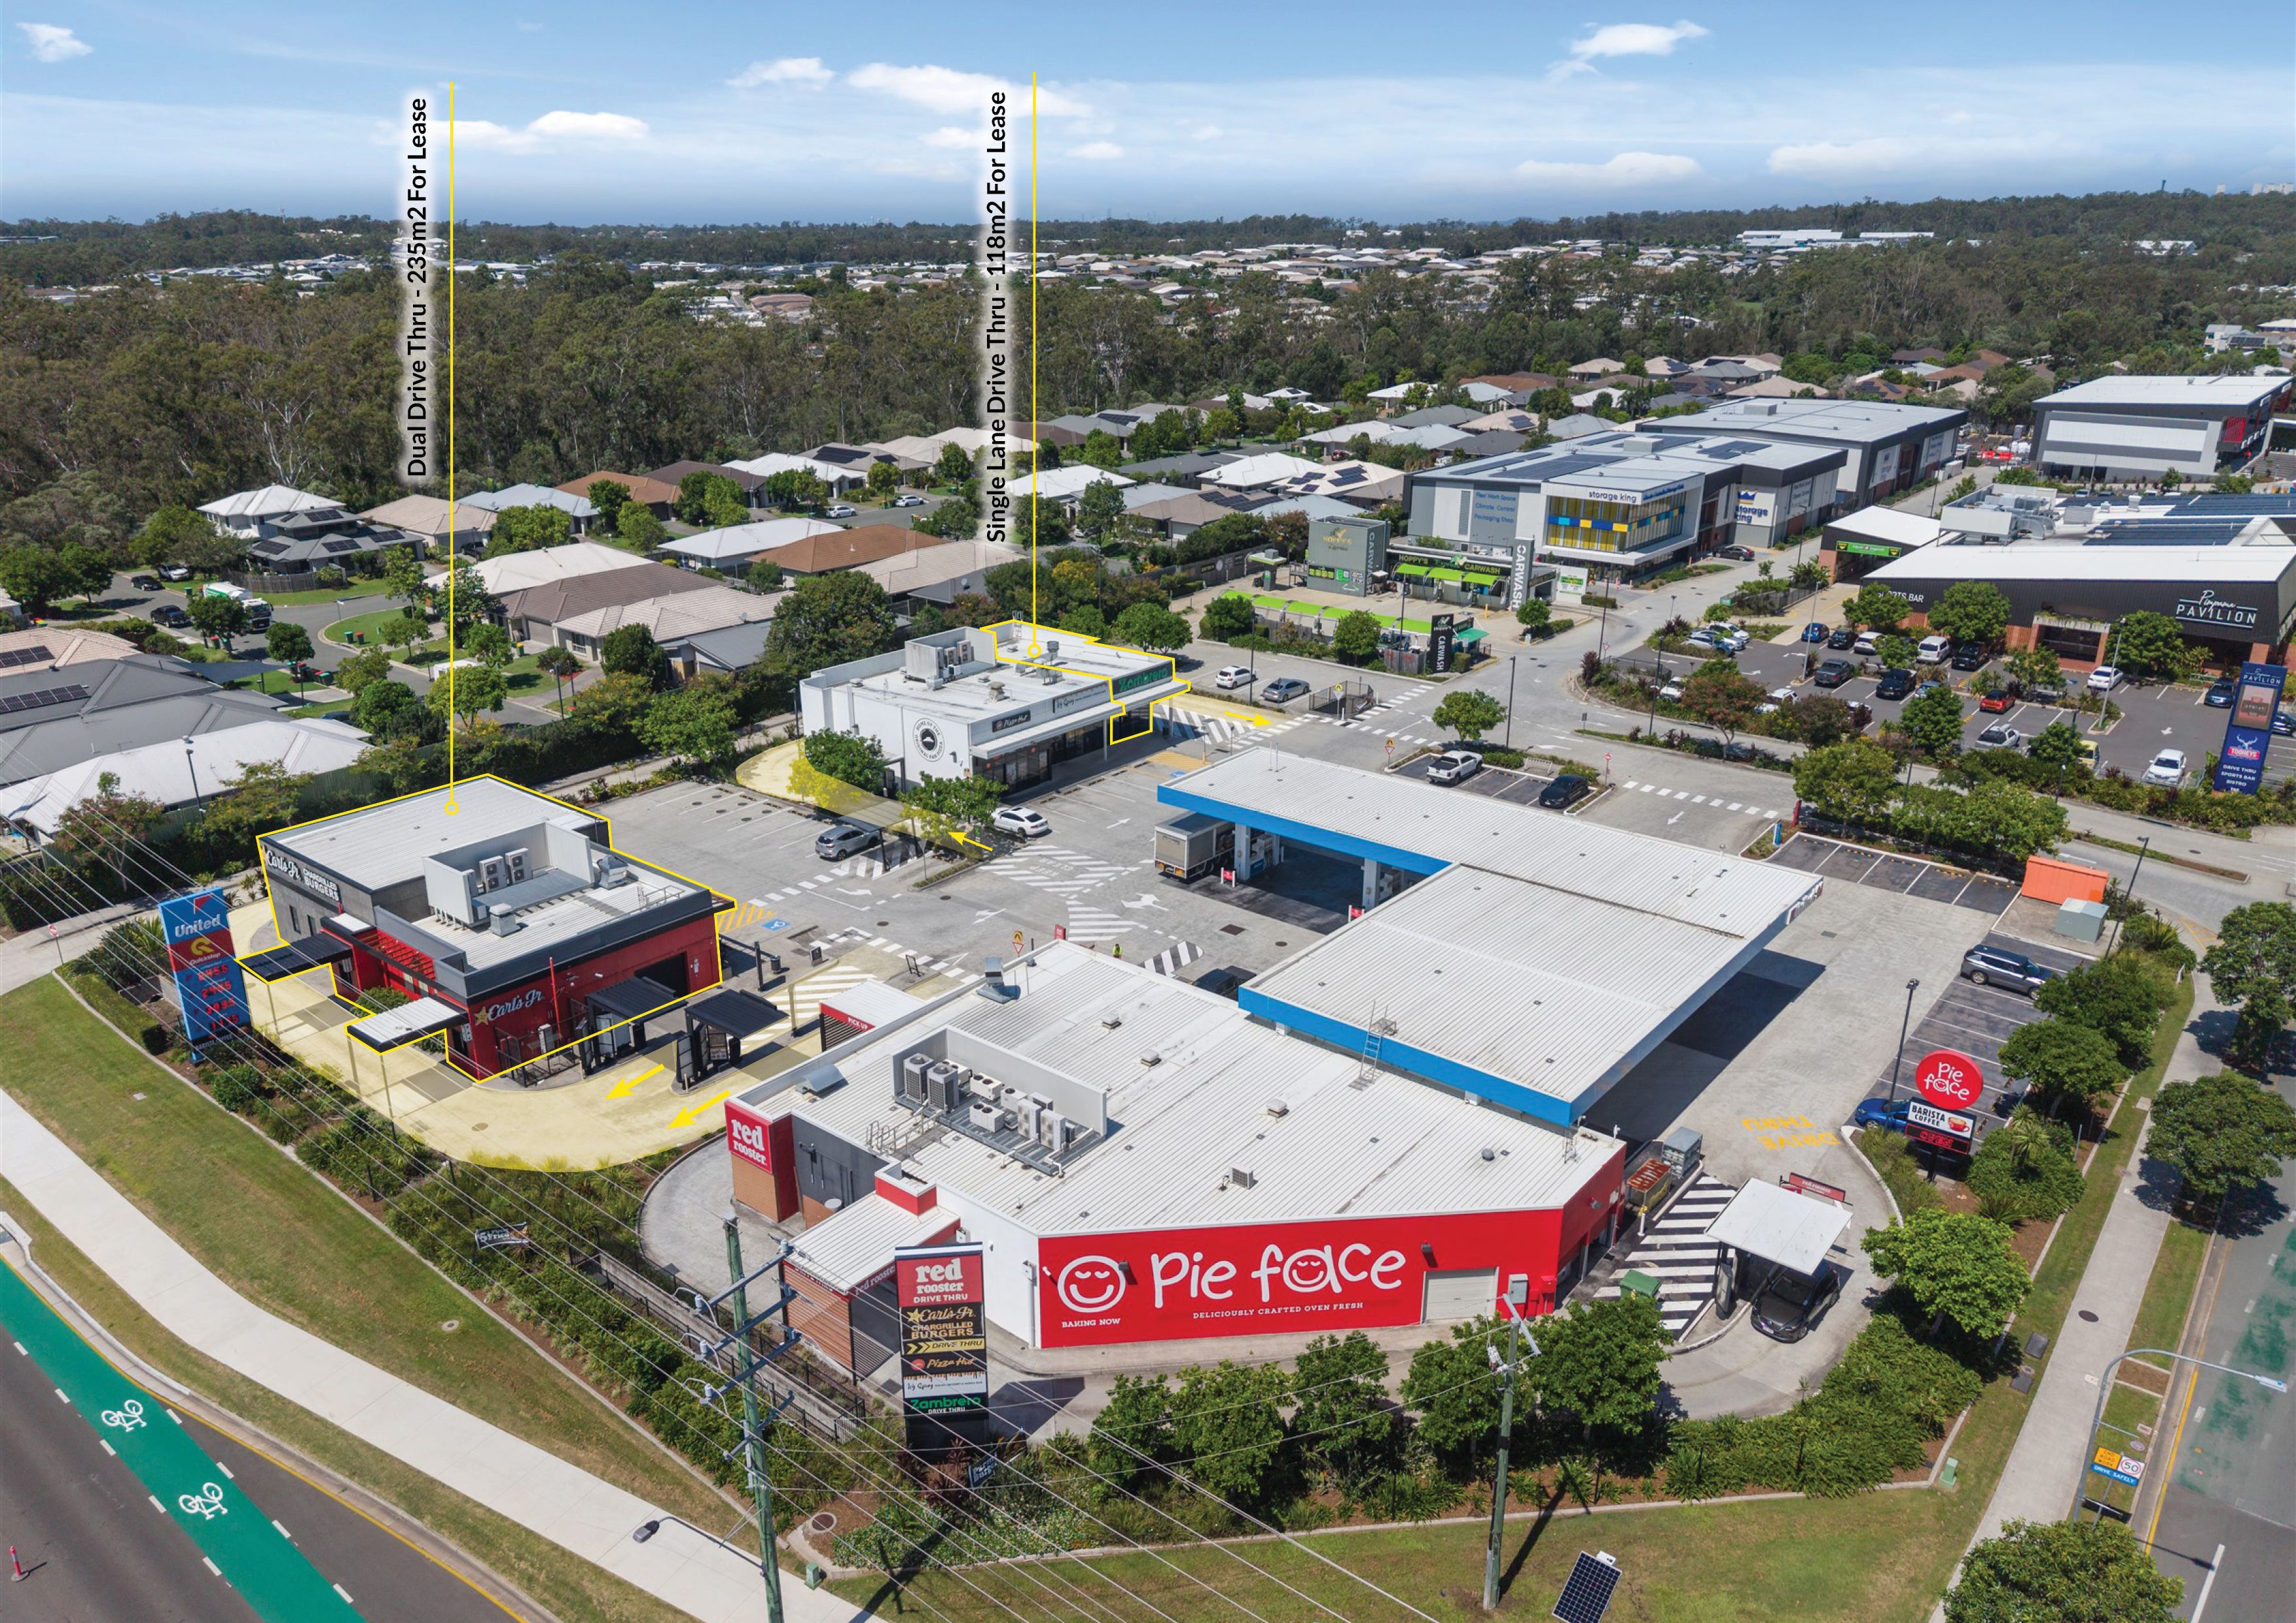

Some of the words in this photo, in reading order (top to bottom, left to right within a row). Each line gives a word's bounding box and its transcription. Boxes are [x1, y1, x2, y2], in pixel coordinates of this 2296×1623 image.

[1588, 491, 1618, 501] storage
[1620, 493, 1637, 503] king
[1399, 554, 1428, 564] HOPPY'S
[1464, 563, 1501, 575] CARWASH
[1513, 544, 1526, 608] CARWASH
[1909, 593, 1924, 603] BAR
[2176, 604, 2256, 624] PAVILION
[1437, 635, 1446, 671] CARWASH
[1119, 668, 1168, 692] Zambrero
[2243, 675, 2281, 684] PAVILION
[2231, 748, 2257, 757] TOOHEYS
[266, 849, 288, 872] Carl's
[304, 876, 339, 901] BURGERS
[175, 914, 221, 937] United
[190, 952, 221, 965] Quickstop
[488, 995, 524, 1021] Carl's
[848, 1016, 860, 1026] PICK
[1924, 1073, 1969, 1101] face
[1912, 1105, 1945, 1122] BARISTA
[1914, 1114, 1940, 1127] COFFEE
[1742, 1115, 1817, 1131] THRU
[731, 1119, 765, 1151] red
[1756, 1132, 1841, 1150] DRIVE
[1920, 1130, 1954, 1148] OPEN
[733, 1140, 766, 1166] rooster
[916, 1258, 963, 1282] red
[1251, 1243, 1406, 1302] face
[855, 1279, 869, 1296] red
[870, 1265, 895, 1287] rooste
[916, 1282, 963, 1293] rooster
[914, 1295, 941, 1304] DRIVE
[920, 1307, 956, 1321] Carl's
[1193, 1309, 1255, 1319] DELICIOUSLY
[1258, 1306, 1301, 1315] CRAFTED
[1304, 1304, 1330, 1312] OVEN
[911, 1321, 973, 1331] CHARGRILLED
[1062, 1319, 1096, 1328] BAKING
[911, 1328, 974, 1340] BURGERS
[927, 1359, 955, 1368] Pizza
[956, 1357, 976, 1366] Hut
[910, 1397, 981, 1409] Zambrero
[2094, 1465, 2111, 1475] DRIVE
[2113, 1472, 2134, 1483] SAFELY
[2124, 1461, 2139, 1472] 50
